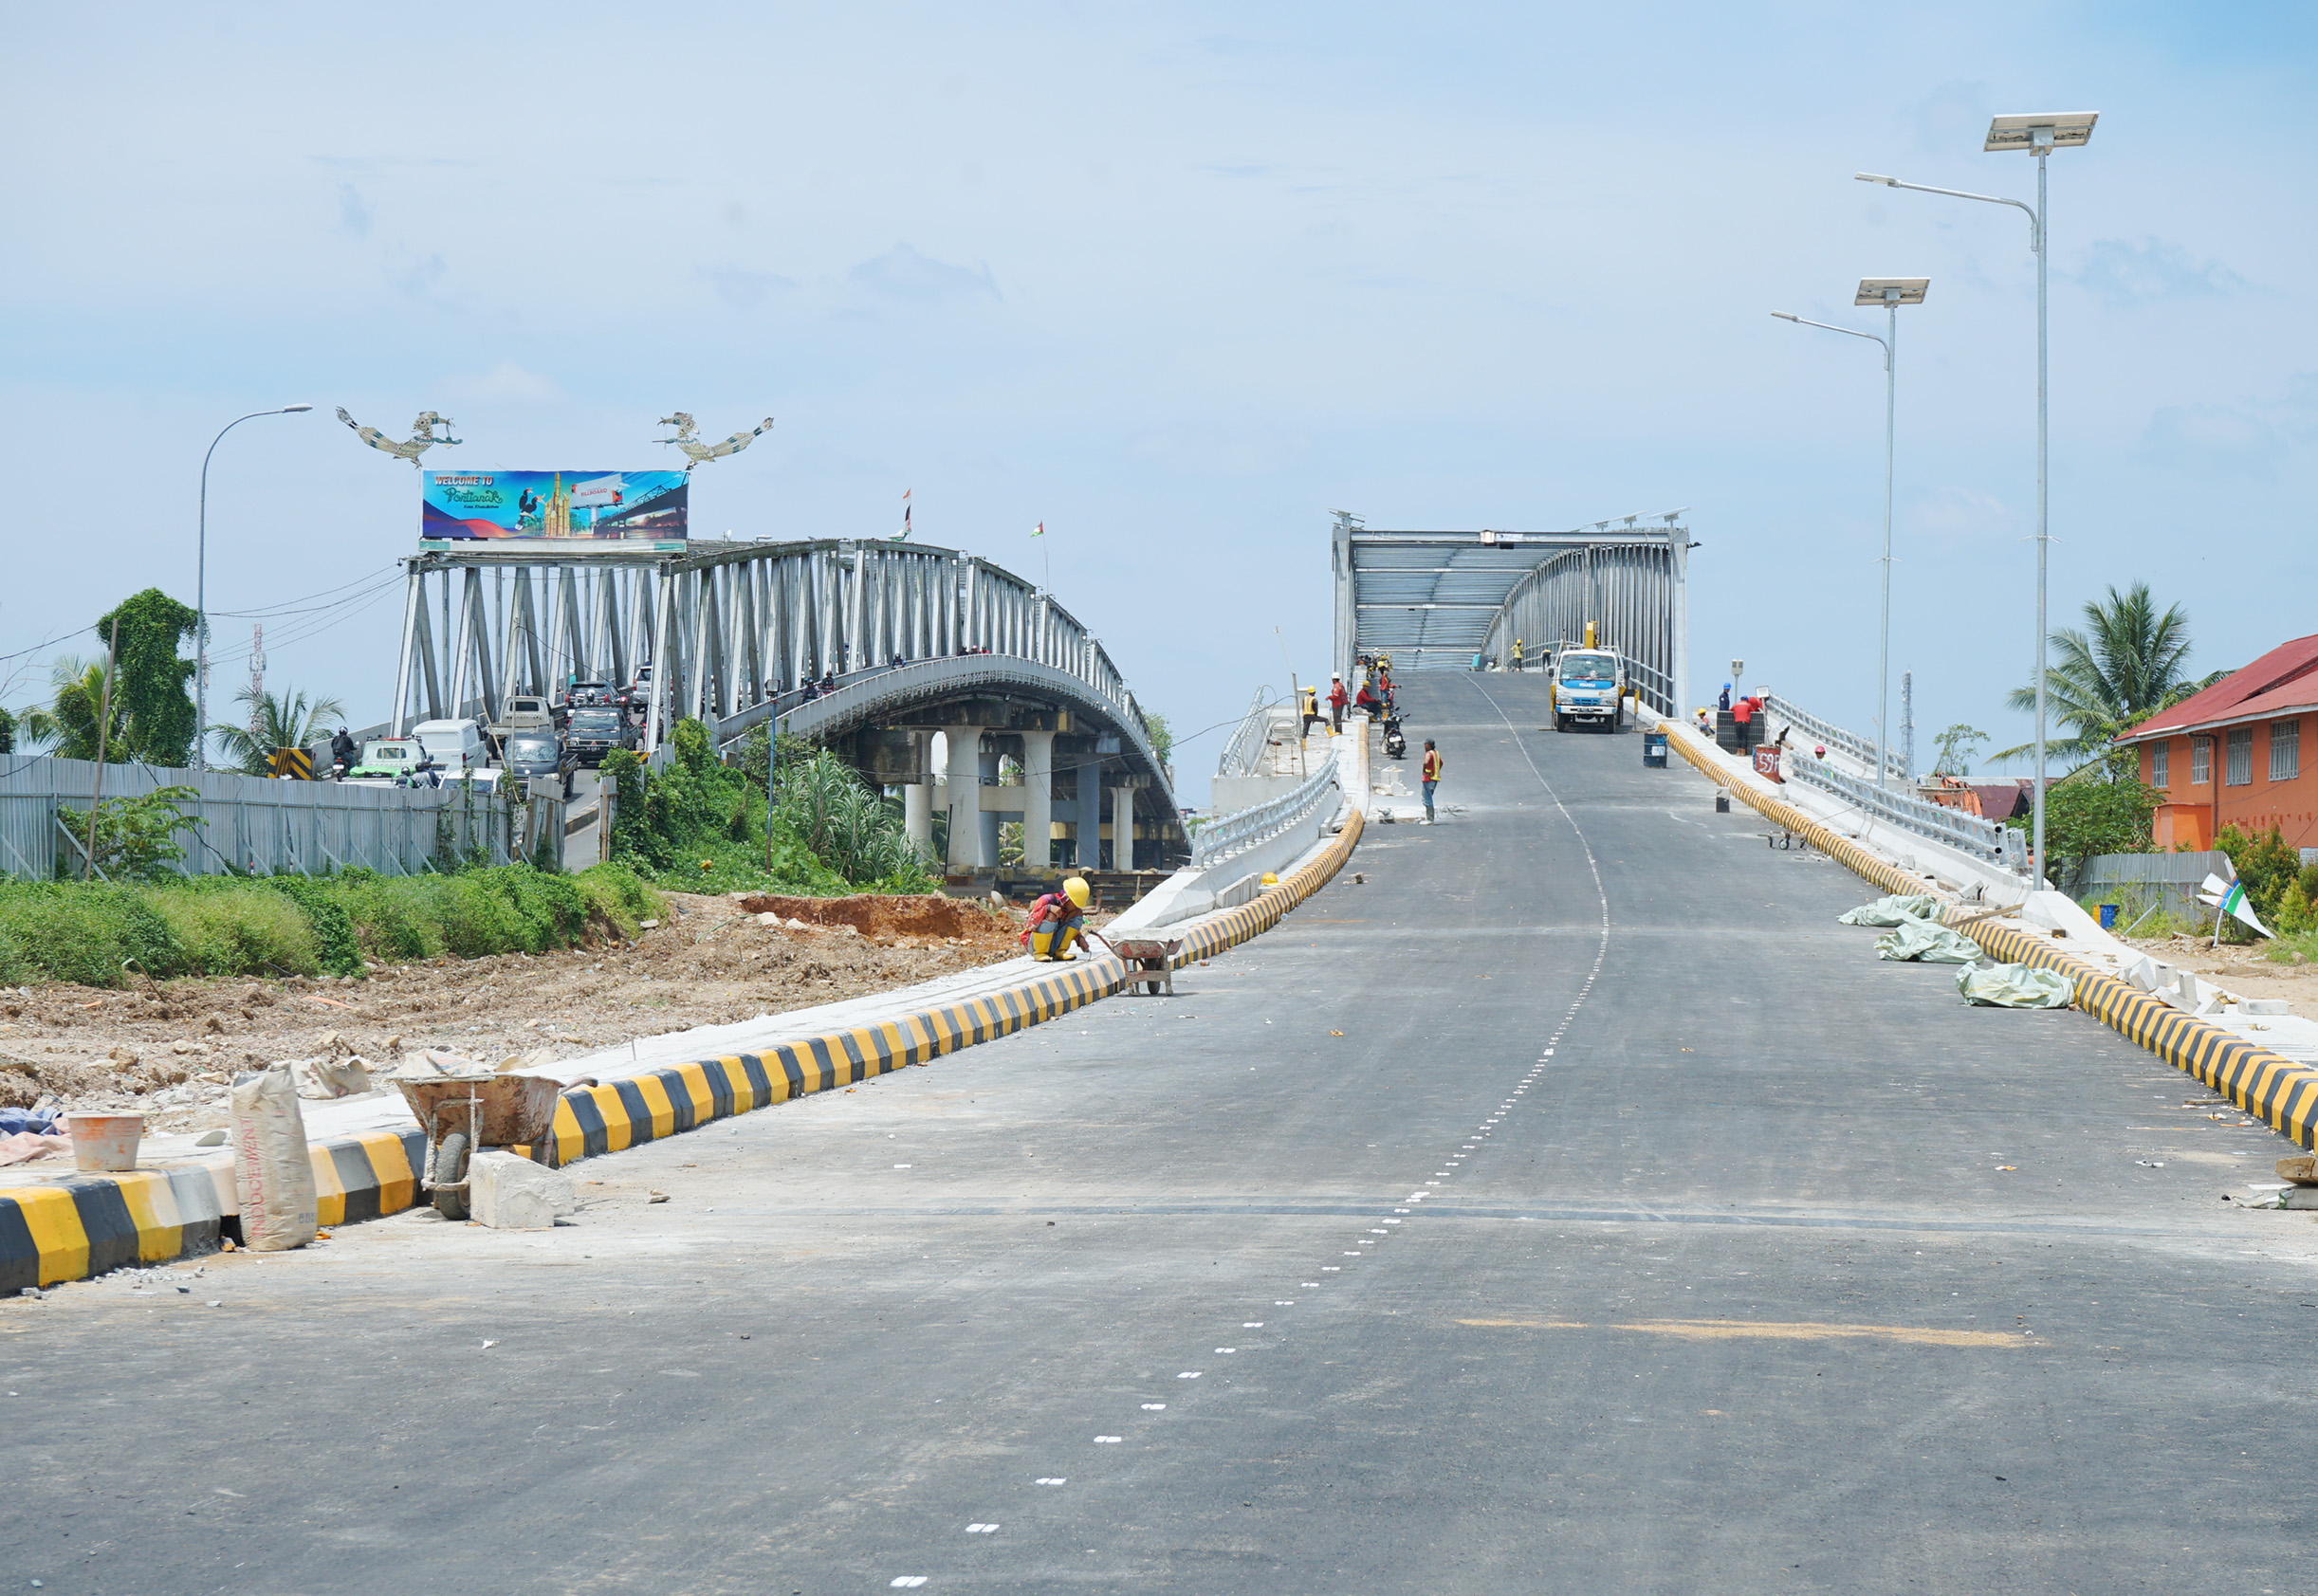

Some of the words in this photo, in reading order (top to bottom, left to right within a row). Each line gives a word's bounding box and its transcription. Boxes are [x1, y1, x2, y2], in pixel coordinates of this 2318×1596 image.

[435, 476, 478, 486] WELCOME
[482, 476, 493, 486] TO
[443, 487, 503, 504] Pontianak
[240, 1118, 266, 1238] INDOCEMENT
